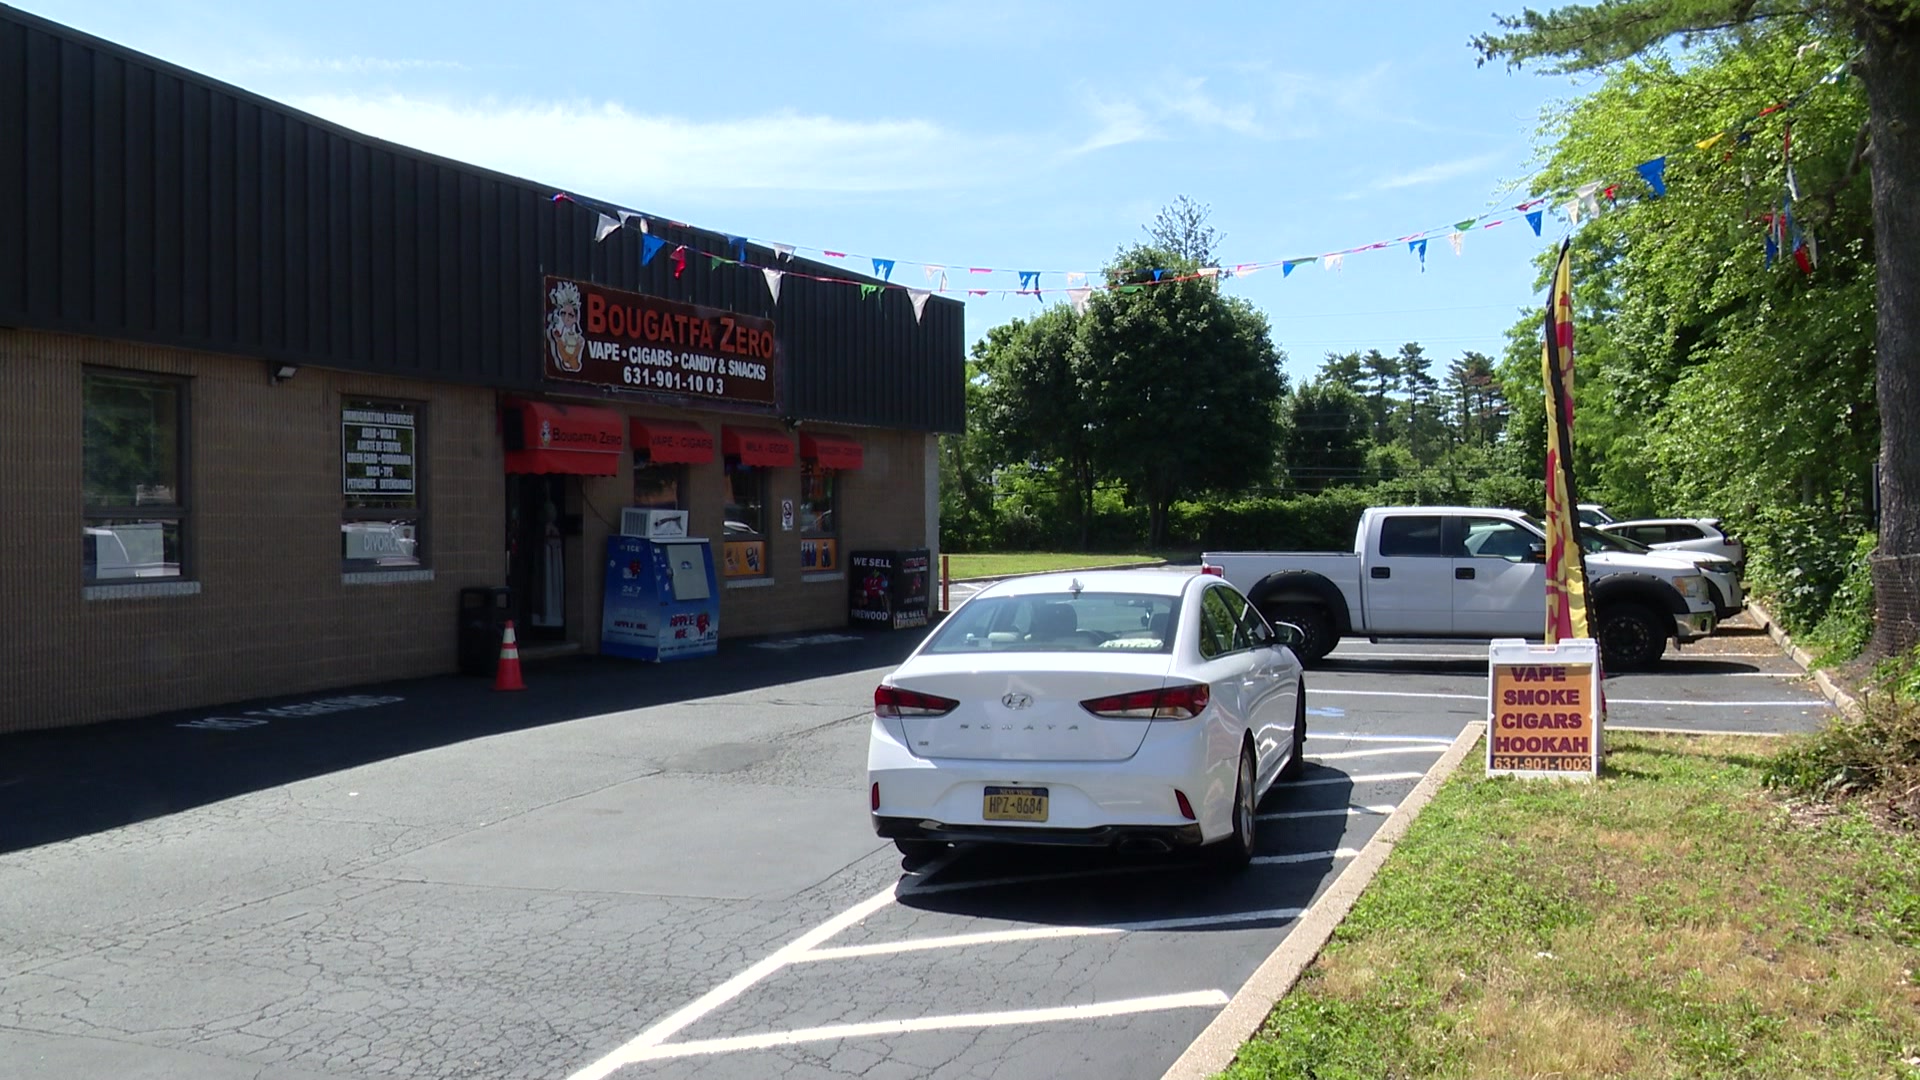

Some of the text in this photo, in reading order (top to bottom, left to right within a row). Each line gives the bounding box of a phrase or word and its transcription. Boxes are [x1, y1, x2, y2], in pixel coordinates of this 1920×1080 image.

[587, 293, 774, 360] BOUGATFA ZERO
[588, 340, 767, 382] VAPE CIGARS CANDY & SNACKS
[623, 367, 725, 396] 631-901-1003
[552, 427, 622, 446] BOUGATFA ZERO
[651, 436, 713, 450] VAPE CIGARS
[853, 557, 867, 567] WE
[868, 558, 892, 568] SELL
[669, 614, 695, 627] APPLE
[851, 608, 888, 621] FIREWOOD
[1511, 667, 1566, 682] VAPE
[1503, 689, 1580, 706] SMOKE
[1501, 713, 1582, 729] CIGARS
[1494, 736, 1589, 753] HOOKAH
[1493, 757, 1591, 771] 631-901-1003
